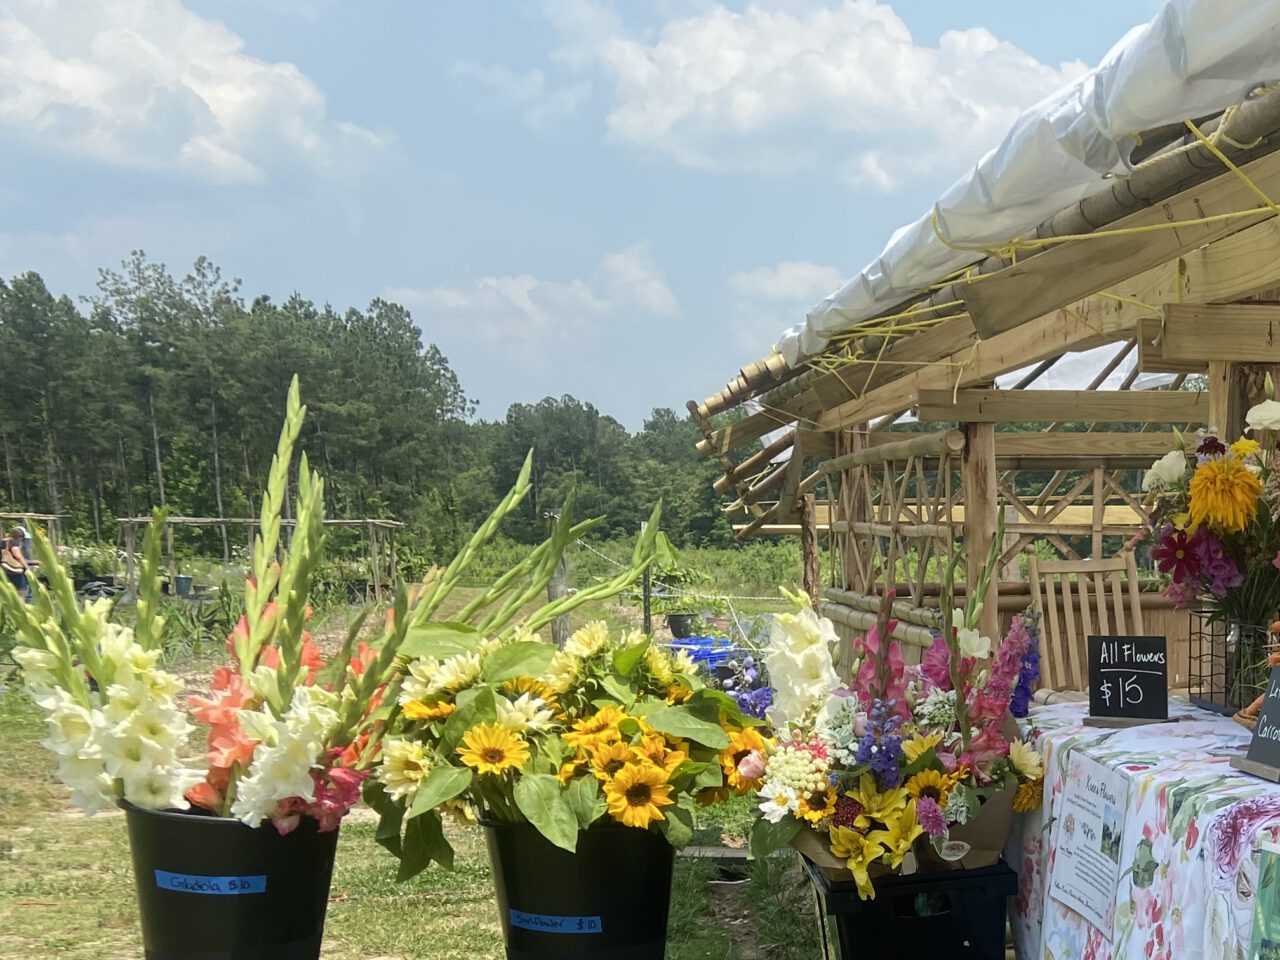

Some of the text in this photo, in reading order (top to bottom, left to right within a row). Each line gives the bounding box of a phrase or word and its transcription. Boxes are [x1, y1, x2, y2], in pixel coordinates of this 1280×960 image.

[1100, 641, 1165, 665] All Flowers
[1099, 674, 1144, 708] $15
